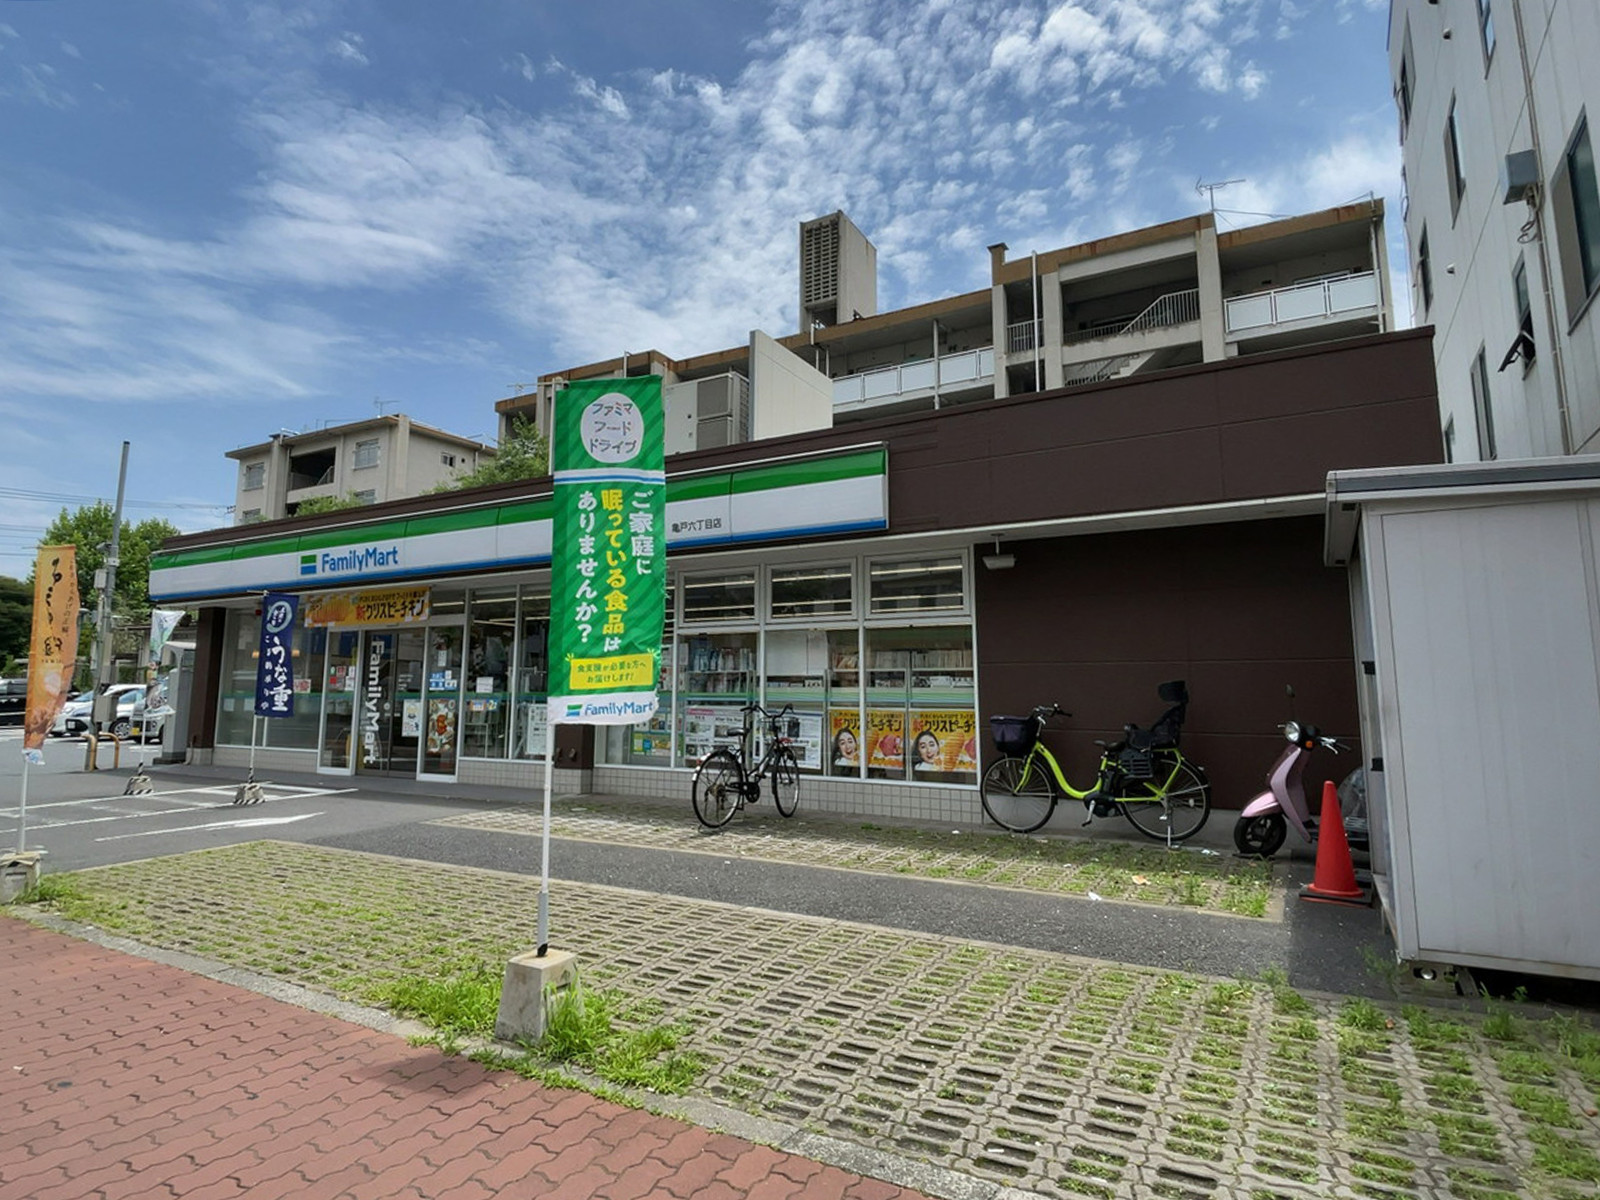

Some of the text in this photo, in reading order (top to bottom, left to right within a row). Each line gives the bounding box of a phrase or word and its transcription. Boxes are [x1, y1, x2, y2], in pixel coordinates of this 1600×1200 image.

[591, 402, 634, 418] ファミマ
[593, 420, 632, 435] フード
[589, 437, 637, 455] ドライブ
[628, 490, 655, 576] ご家庭に
[671, 518, 722, 533] 亀戸六丁目店
[321, 546, 399, 573] FamilyMart
[601, 489, 629, 652] 眠っている食品は
[270, 635, 292, 712] うな重
[363, 640, 385, 764] FamilyMart
[584, 701, 654, 716] FamilyMart
[912, 718, 976, 733] 新クリスピーチ
